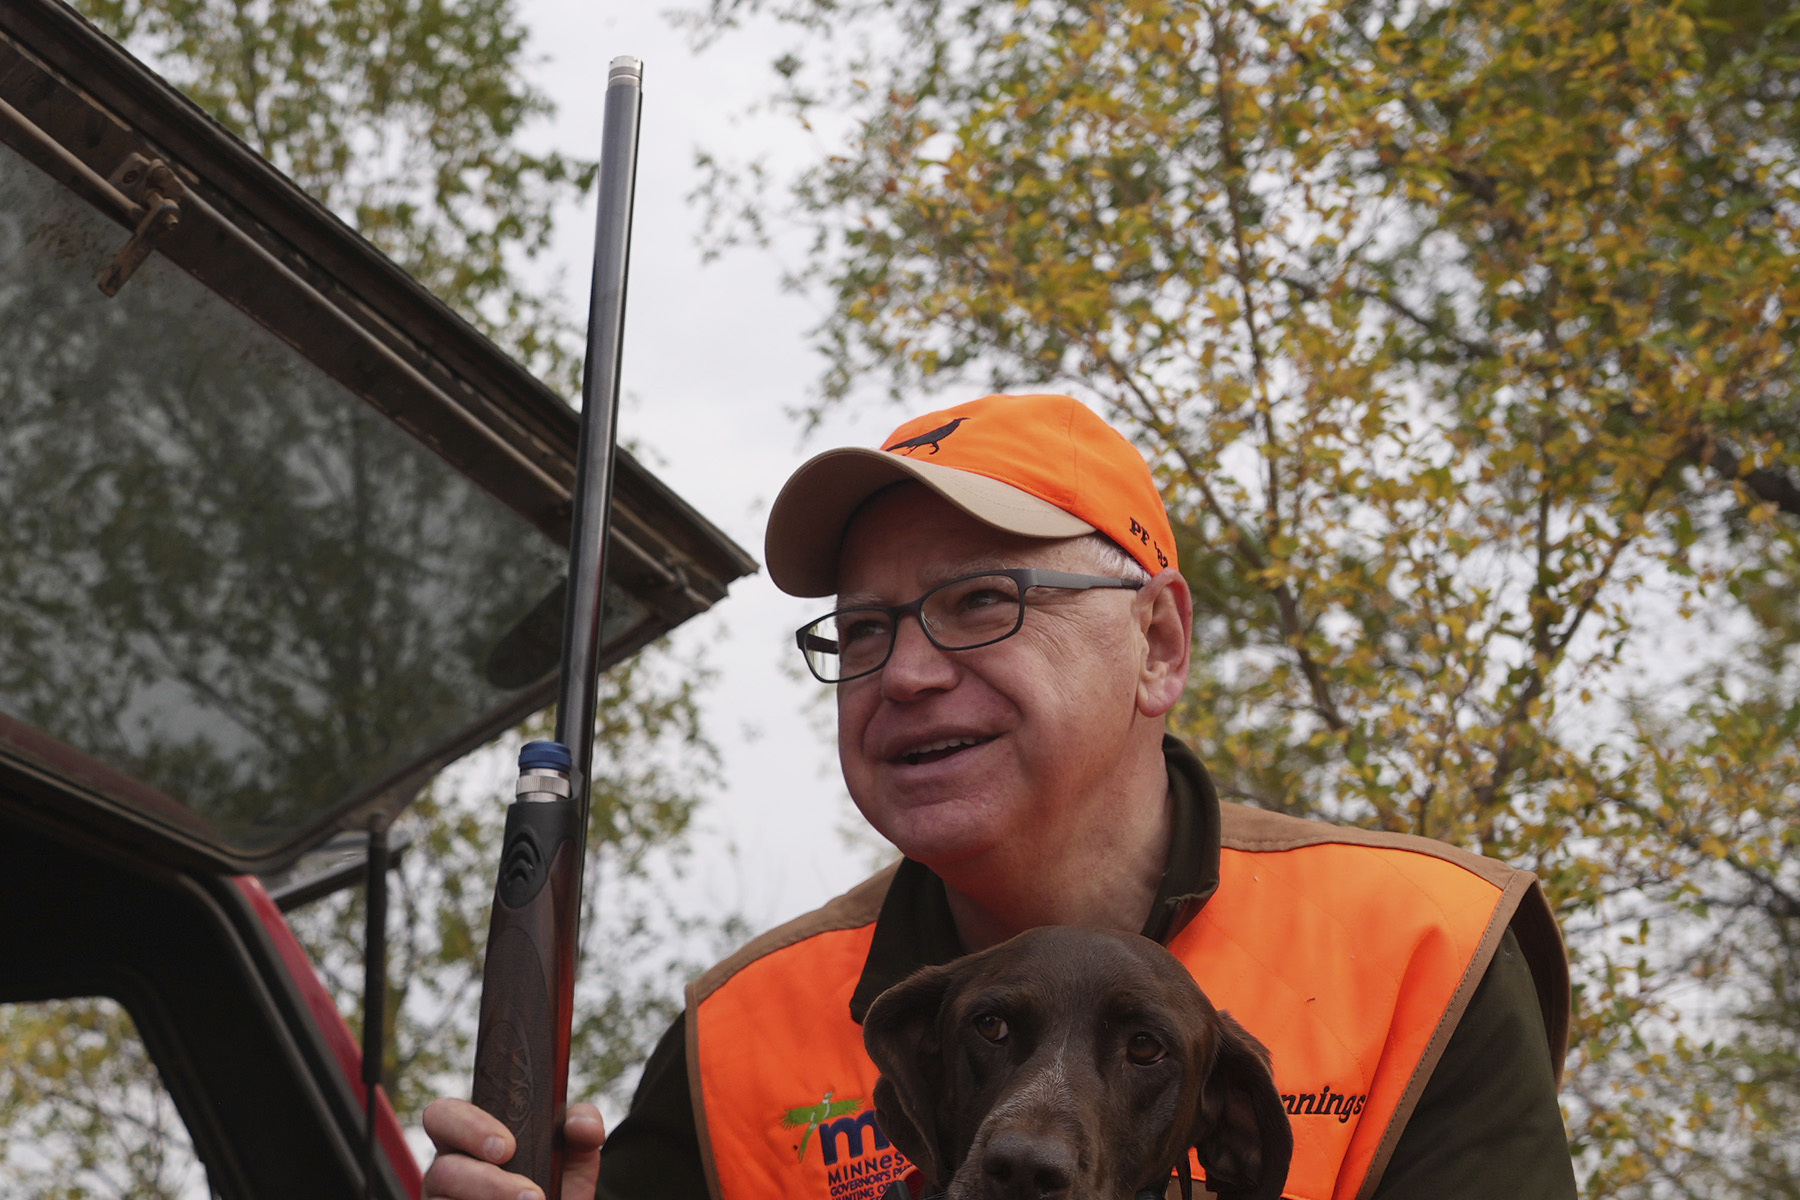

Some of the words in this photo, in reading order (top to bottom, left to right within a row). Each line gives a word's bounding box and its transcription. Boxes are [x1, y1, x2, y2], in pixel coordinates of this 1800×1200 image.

[1129, 516, 1150, 546] PF
[1280, 1085, 1367, 1124] nnings
[819, 1110, 890, 1166] m
[828, 1151, 906, 1187] MINNeS
[830, 1170, 892, 1197] GOVERNOR'S
